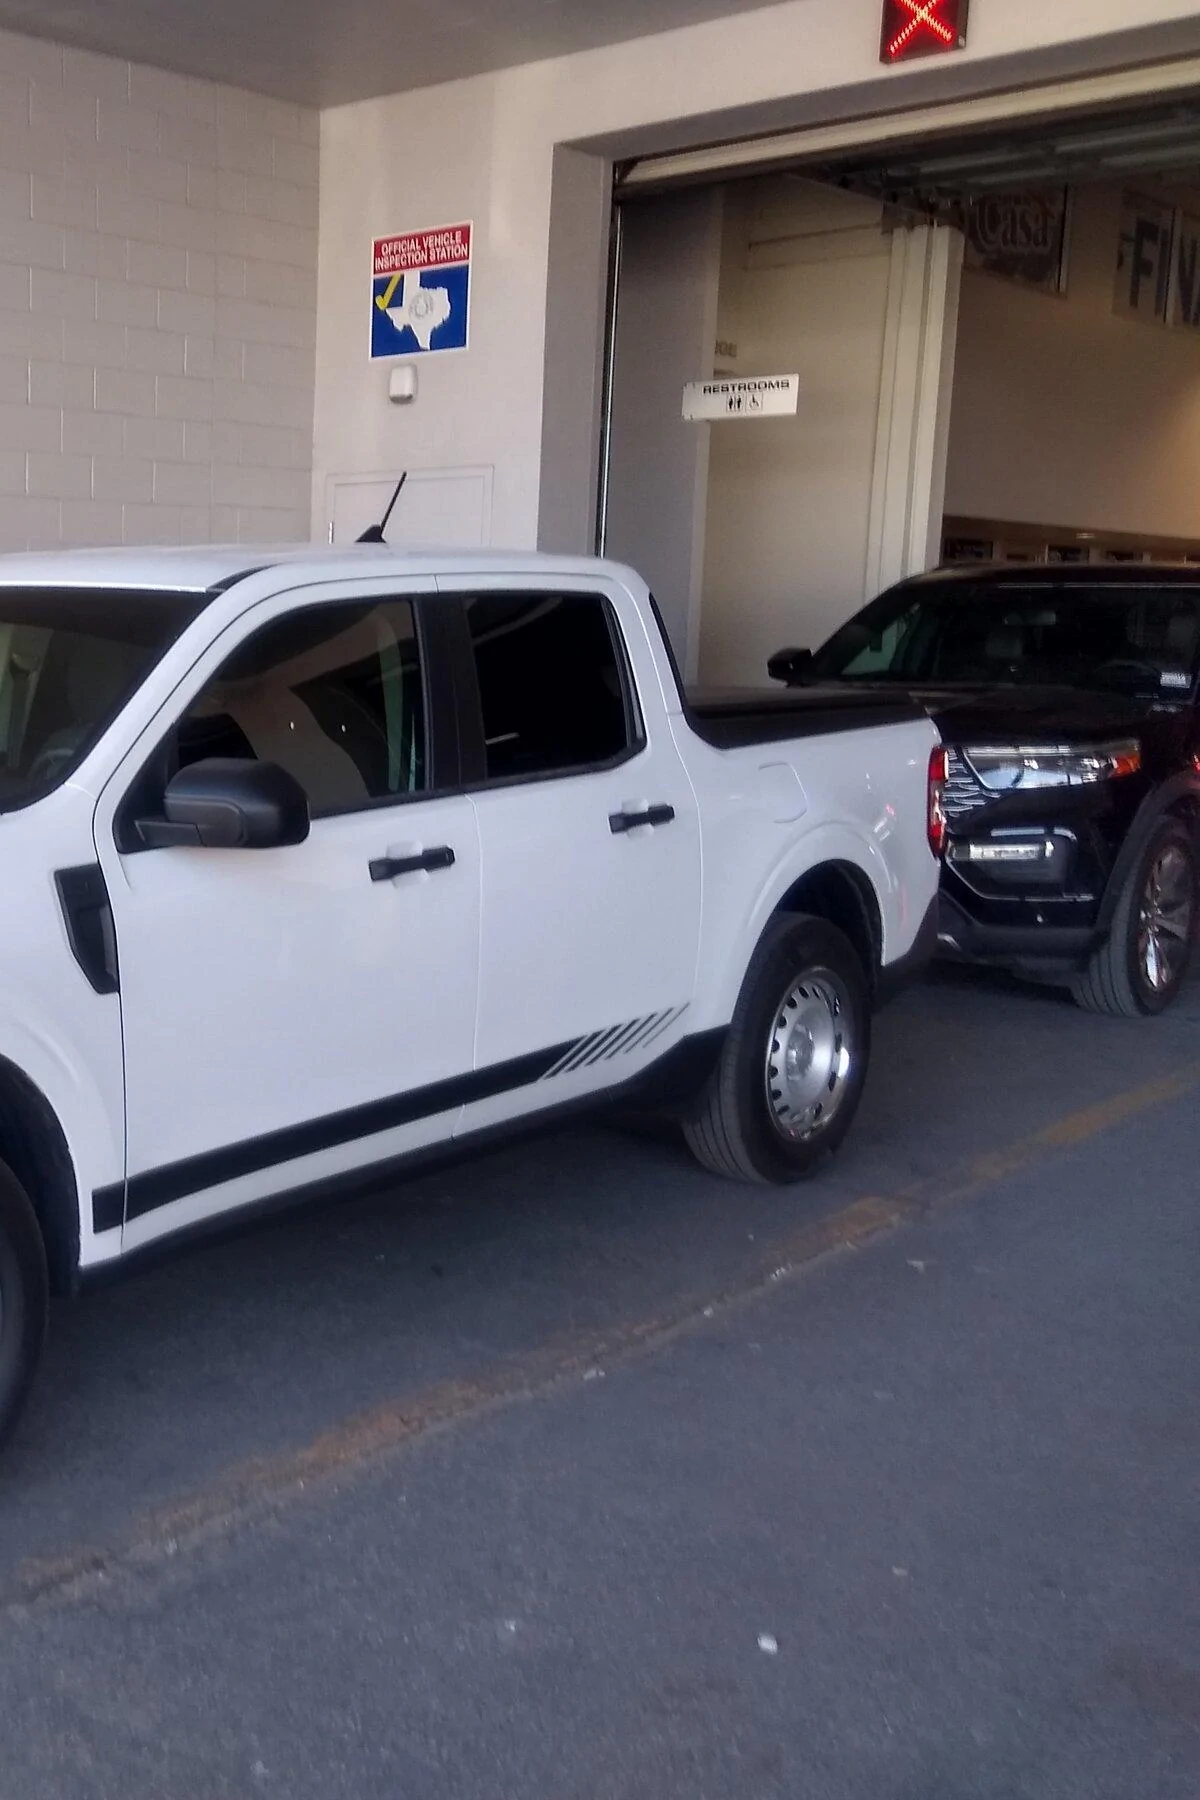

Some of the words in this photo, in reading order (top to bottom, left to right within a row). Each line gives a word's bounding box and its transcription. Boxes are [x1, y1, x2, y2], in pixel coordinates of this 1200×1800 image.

[381, 240, 421, 255] OFFICIAL
[423, 230, 462, 248] VEHICLE
[375, 251, 428, 271] INSPECTION
[429, 243, 468, 263] STATION
[702, 379, 790, 395] RESTROOMS
